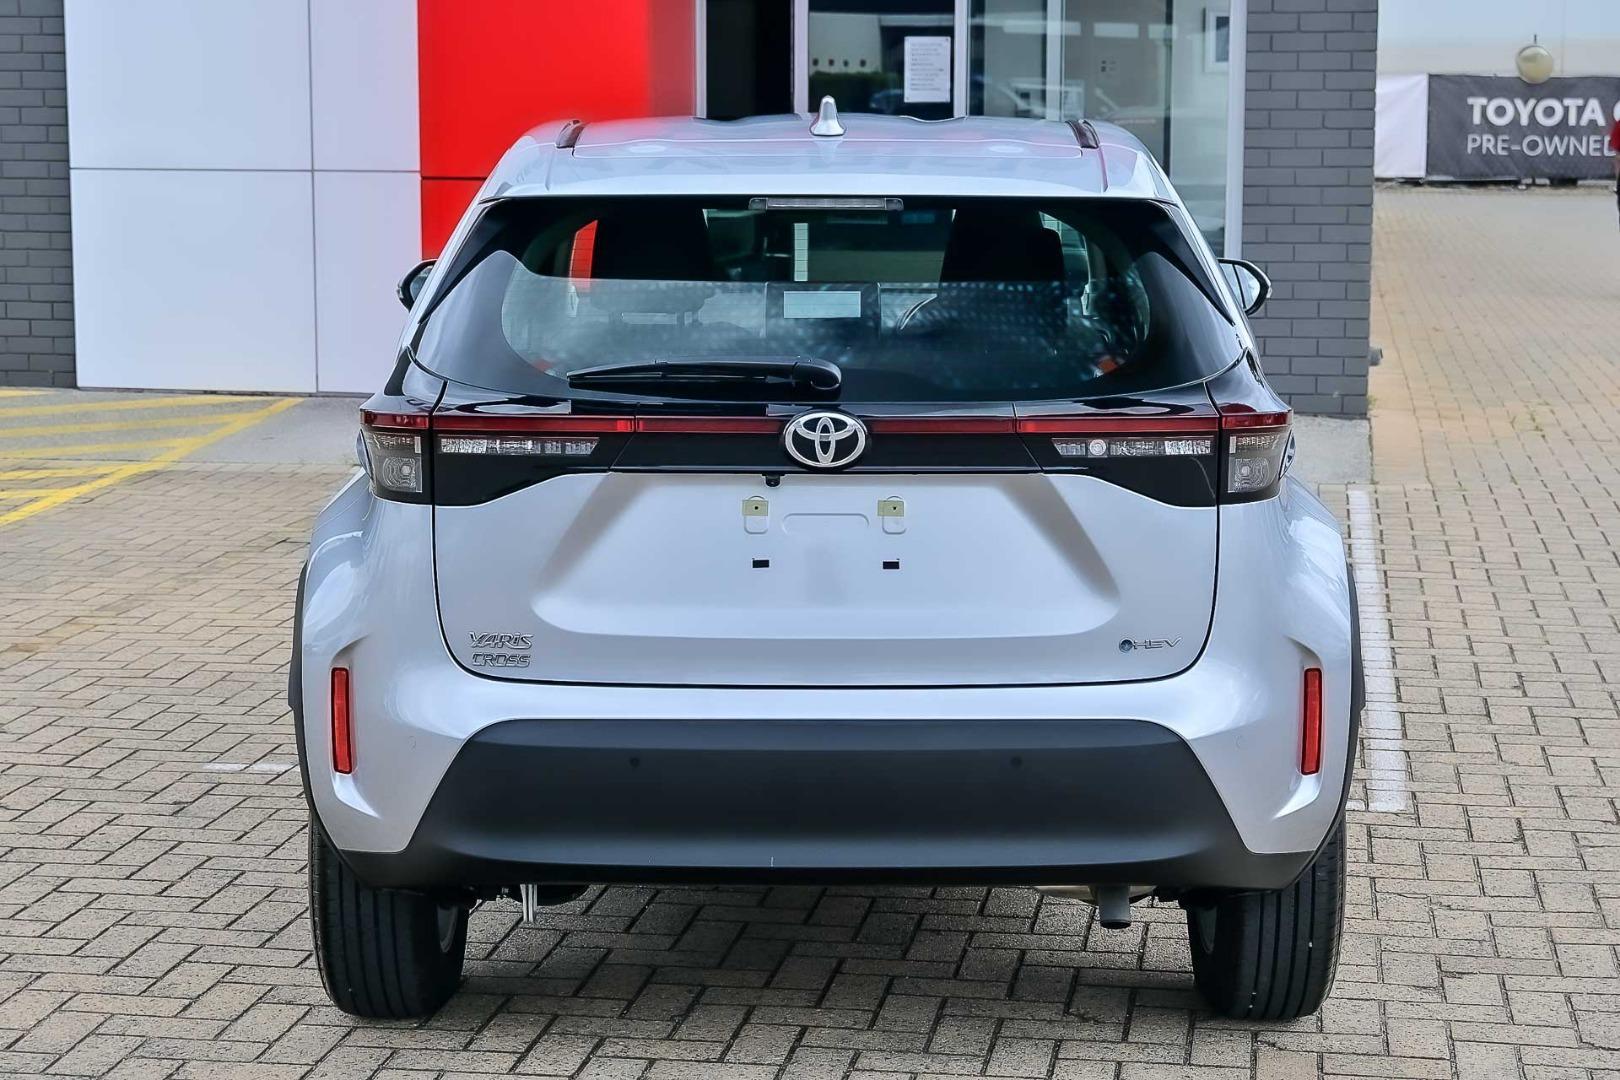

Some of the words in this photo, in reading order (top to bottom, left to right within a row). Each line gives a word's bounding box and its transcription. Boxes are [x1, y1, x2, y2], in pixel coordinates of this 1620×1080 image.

[1466, 97, 1606, 127] TOYOTA
[1133, 636, 1182, 650] HEV
[472, 652, 531, 668] CROSS
